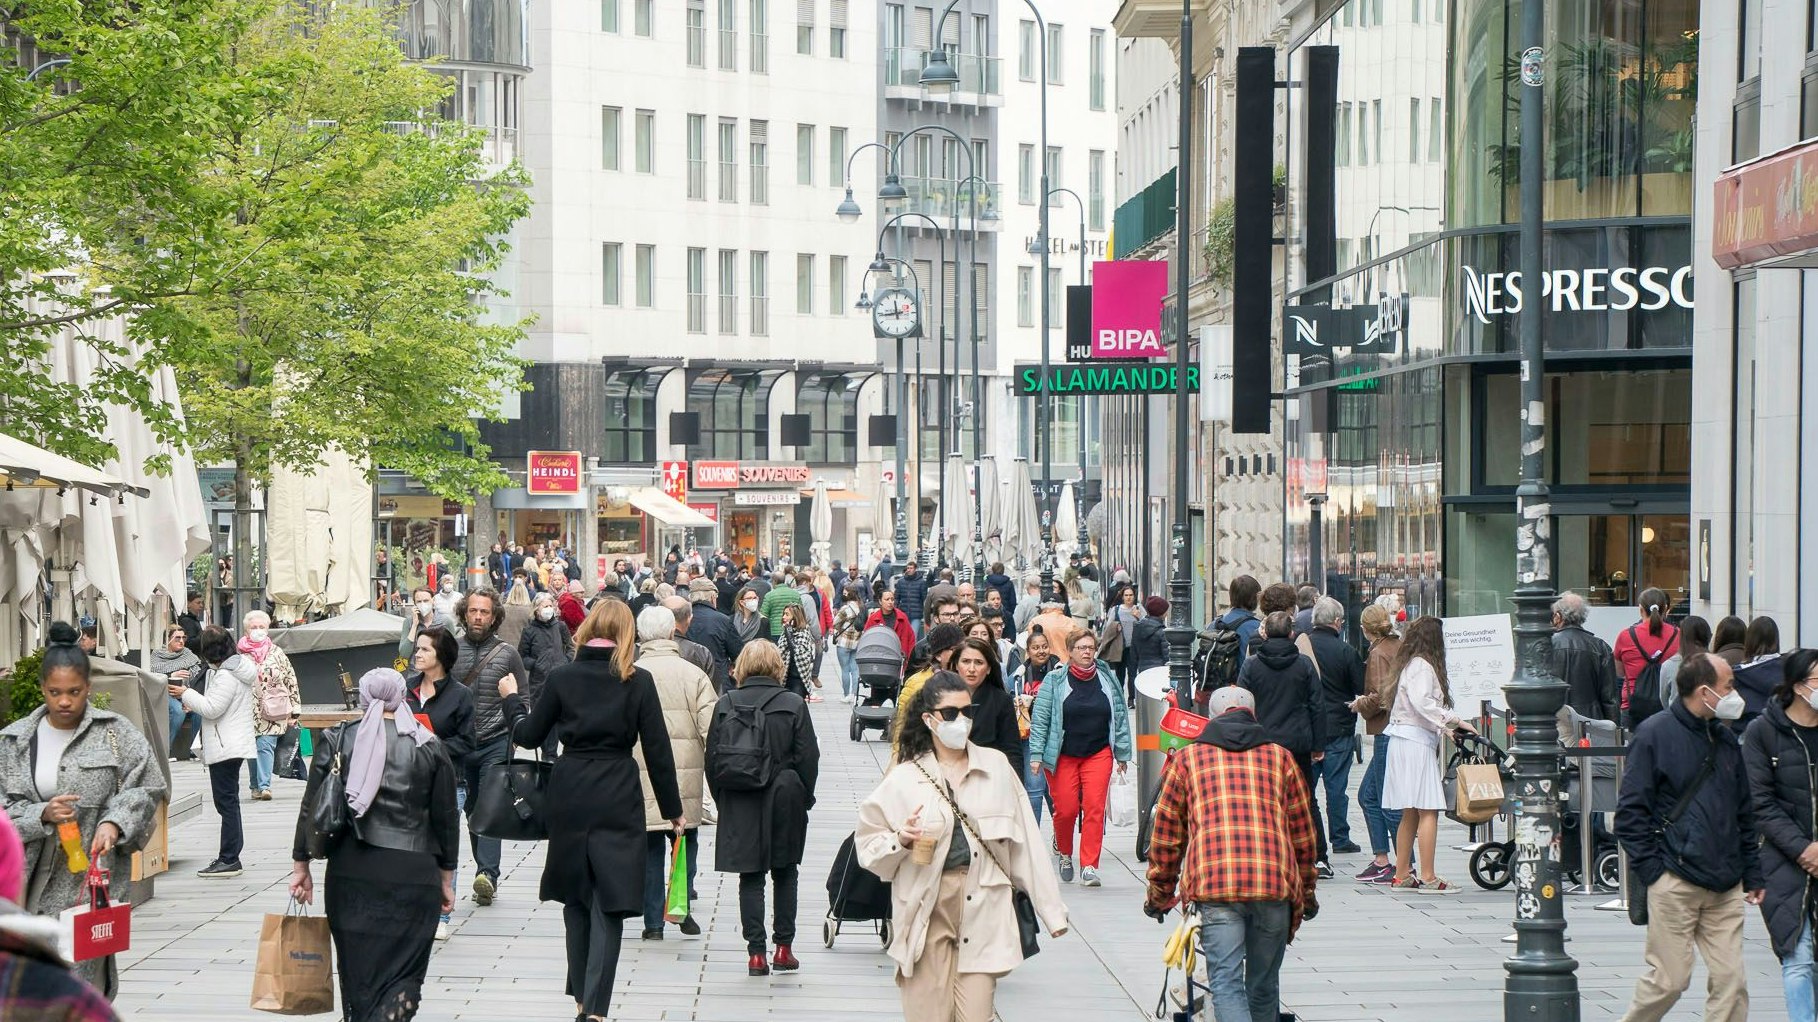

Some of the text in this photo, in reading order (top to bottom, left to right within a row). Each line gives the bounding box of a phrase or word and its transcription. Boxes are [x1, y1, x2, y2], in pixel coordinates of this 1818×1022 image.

[1025, 236, 1066, 253] HEL
[1083, 240, 1108, 256] STE
[1100, 330, 1160, 350] BIPA
[1070, 345, 1092, 358] HU
[533, 468, 576, 476] HEINDL
[700, 466, 737, 483] SOUVENIRS
[742, 466, 812, 482] SOUVENIRS
[746, 494, 790, 503] SOUVENIRS
[1463, 629, 1496, 637] Gesundheit
